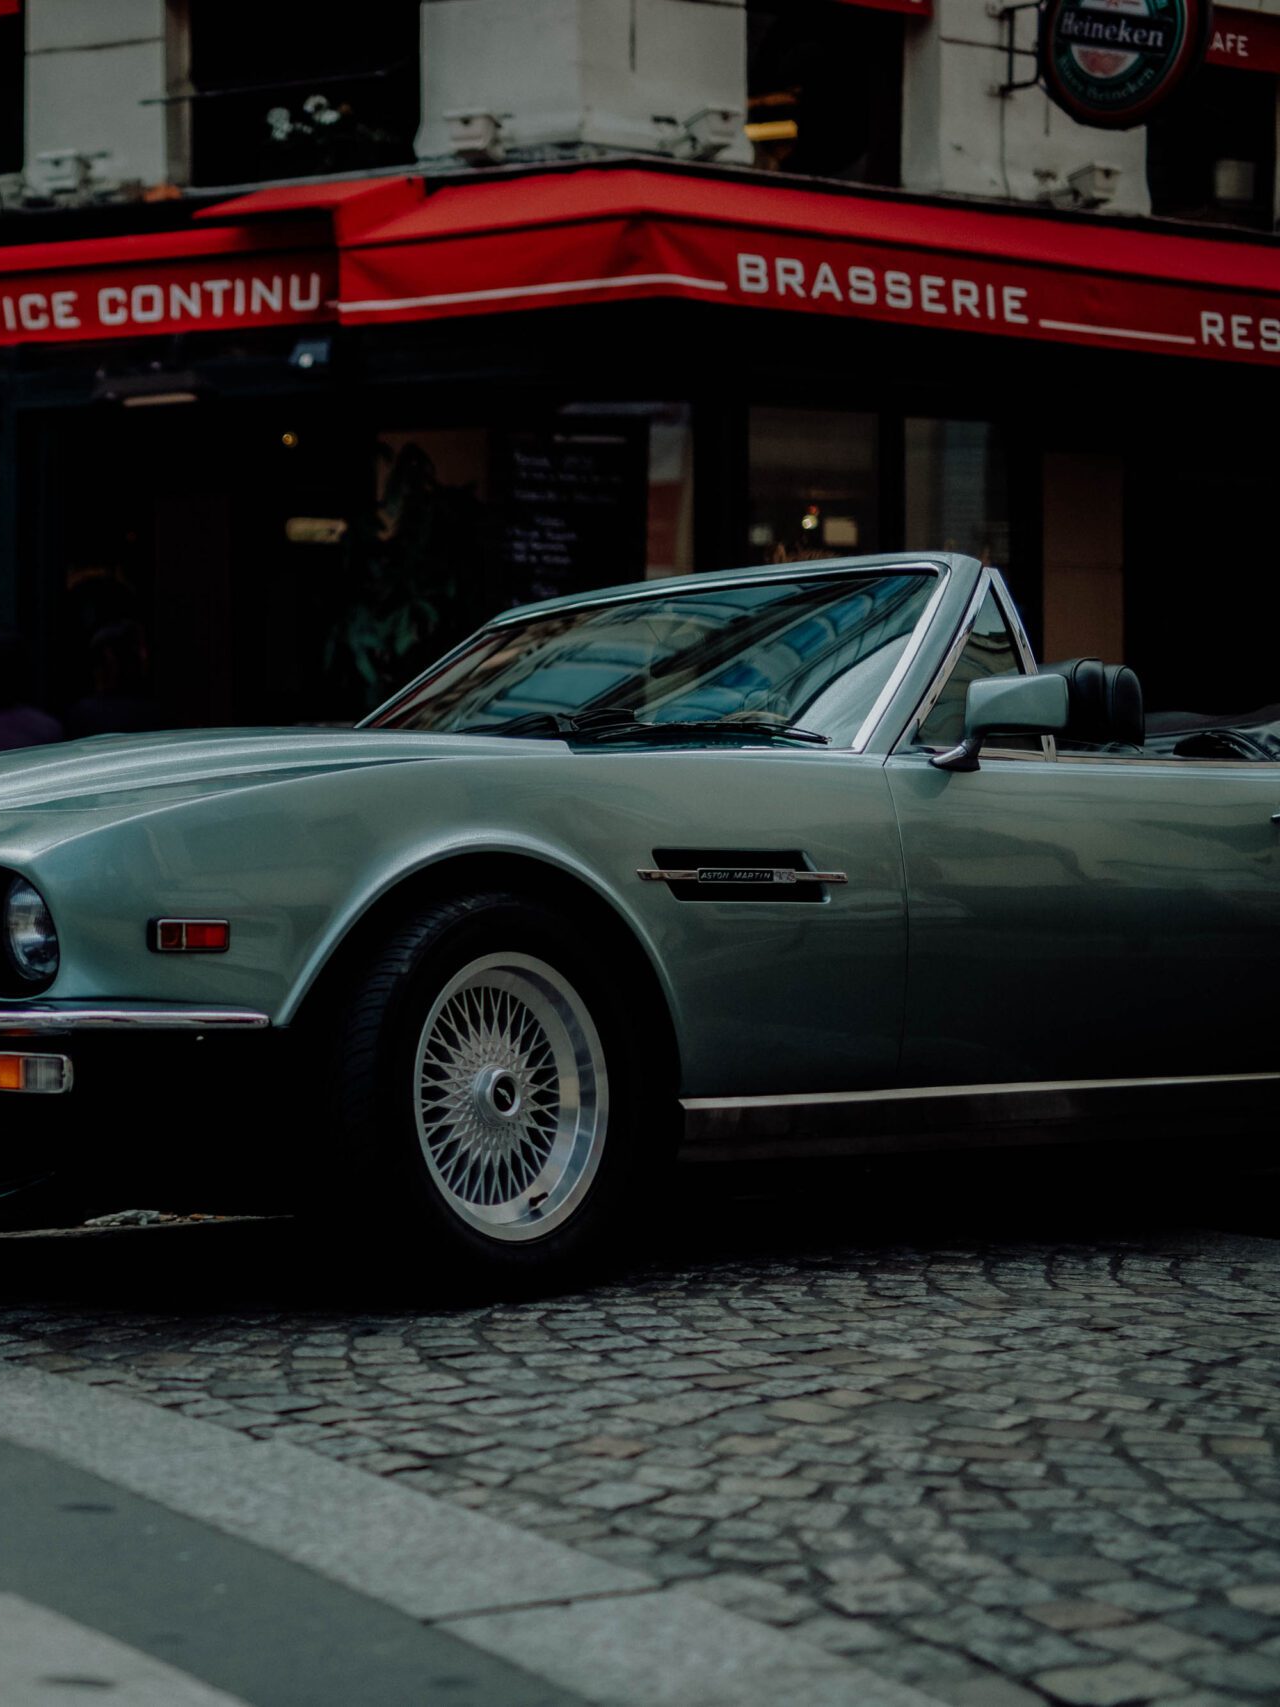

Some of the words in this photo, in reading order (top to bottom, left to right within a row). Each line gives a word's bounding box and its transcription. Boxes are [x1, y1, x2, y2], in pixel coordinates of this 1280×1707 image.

[1060, 11, 1164, 47] Heineken
[1210, 31, 1249, 57] AFE
[99, 275, 320, 326] CONTINU
[737, 253, 1029, 325] BRASSERIE
[700, 872, 730, 880] ASTON
[732, 872, 771, 880] MARTIN
